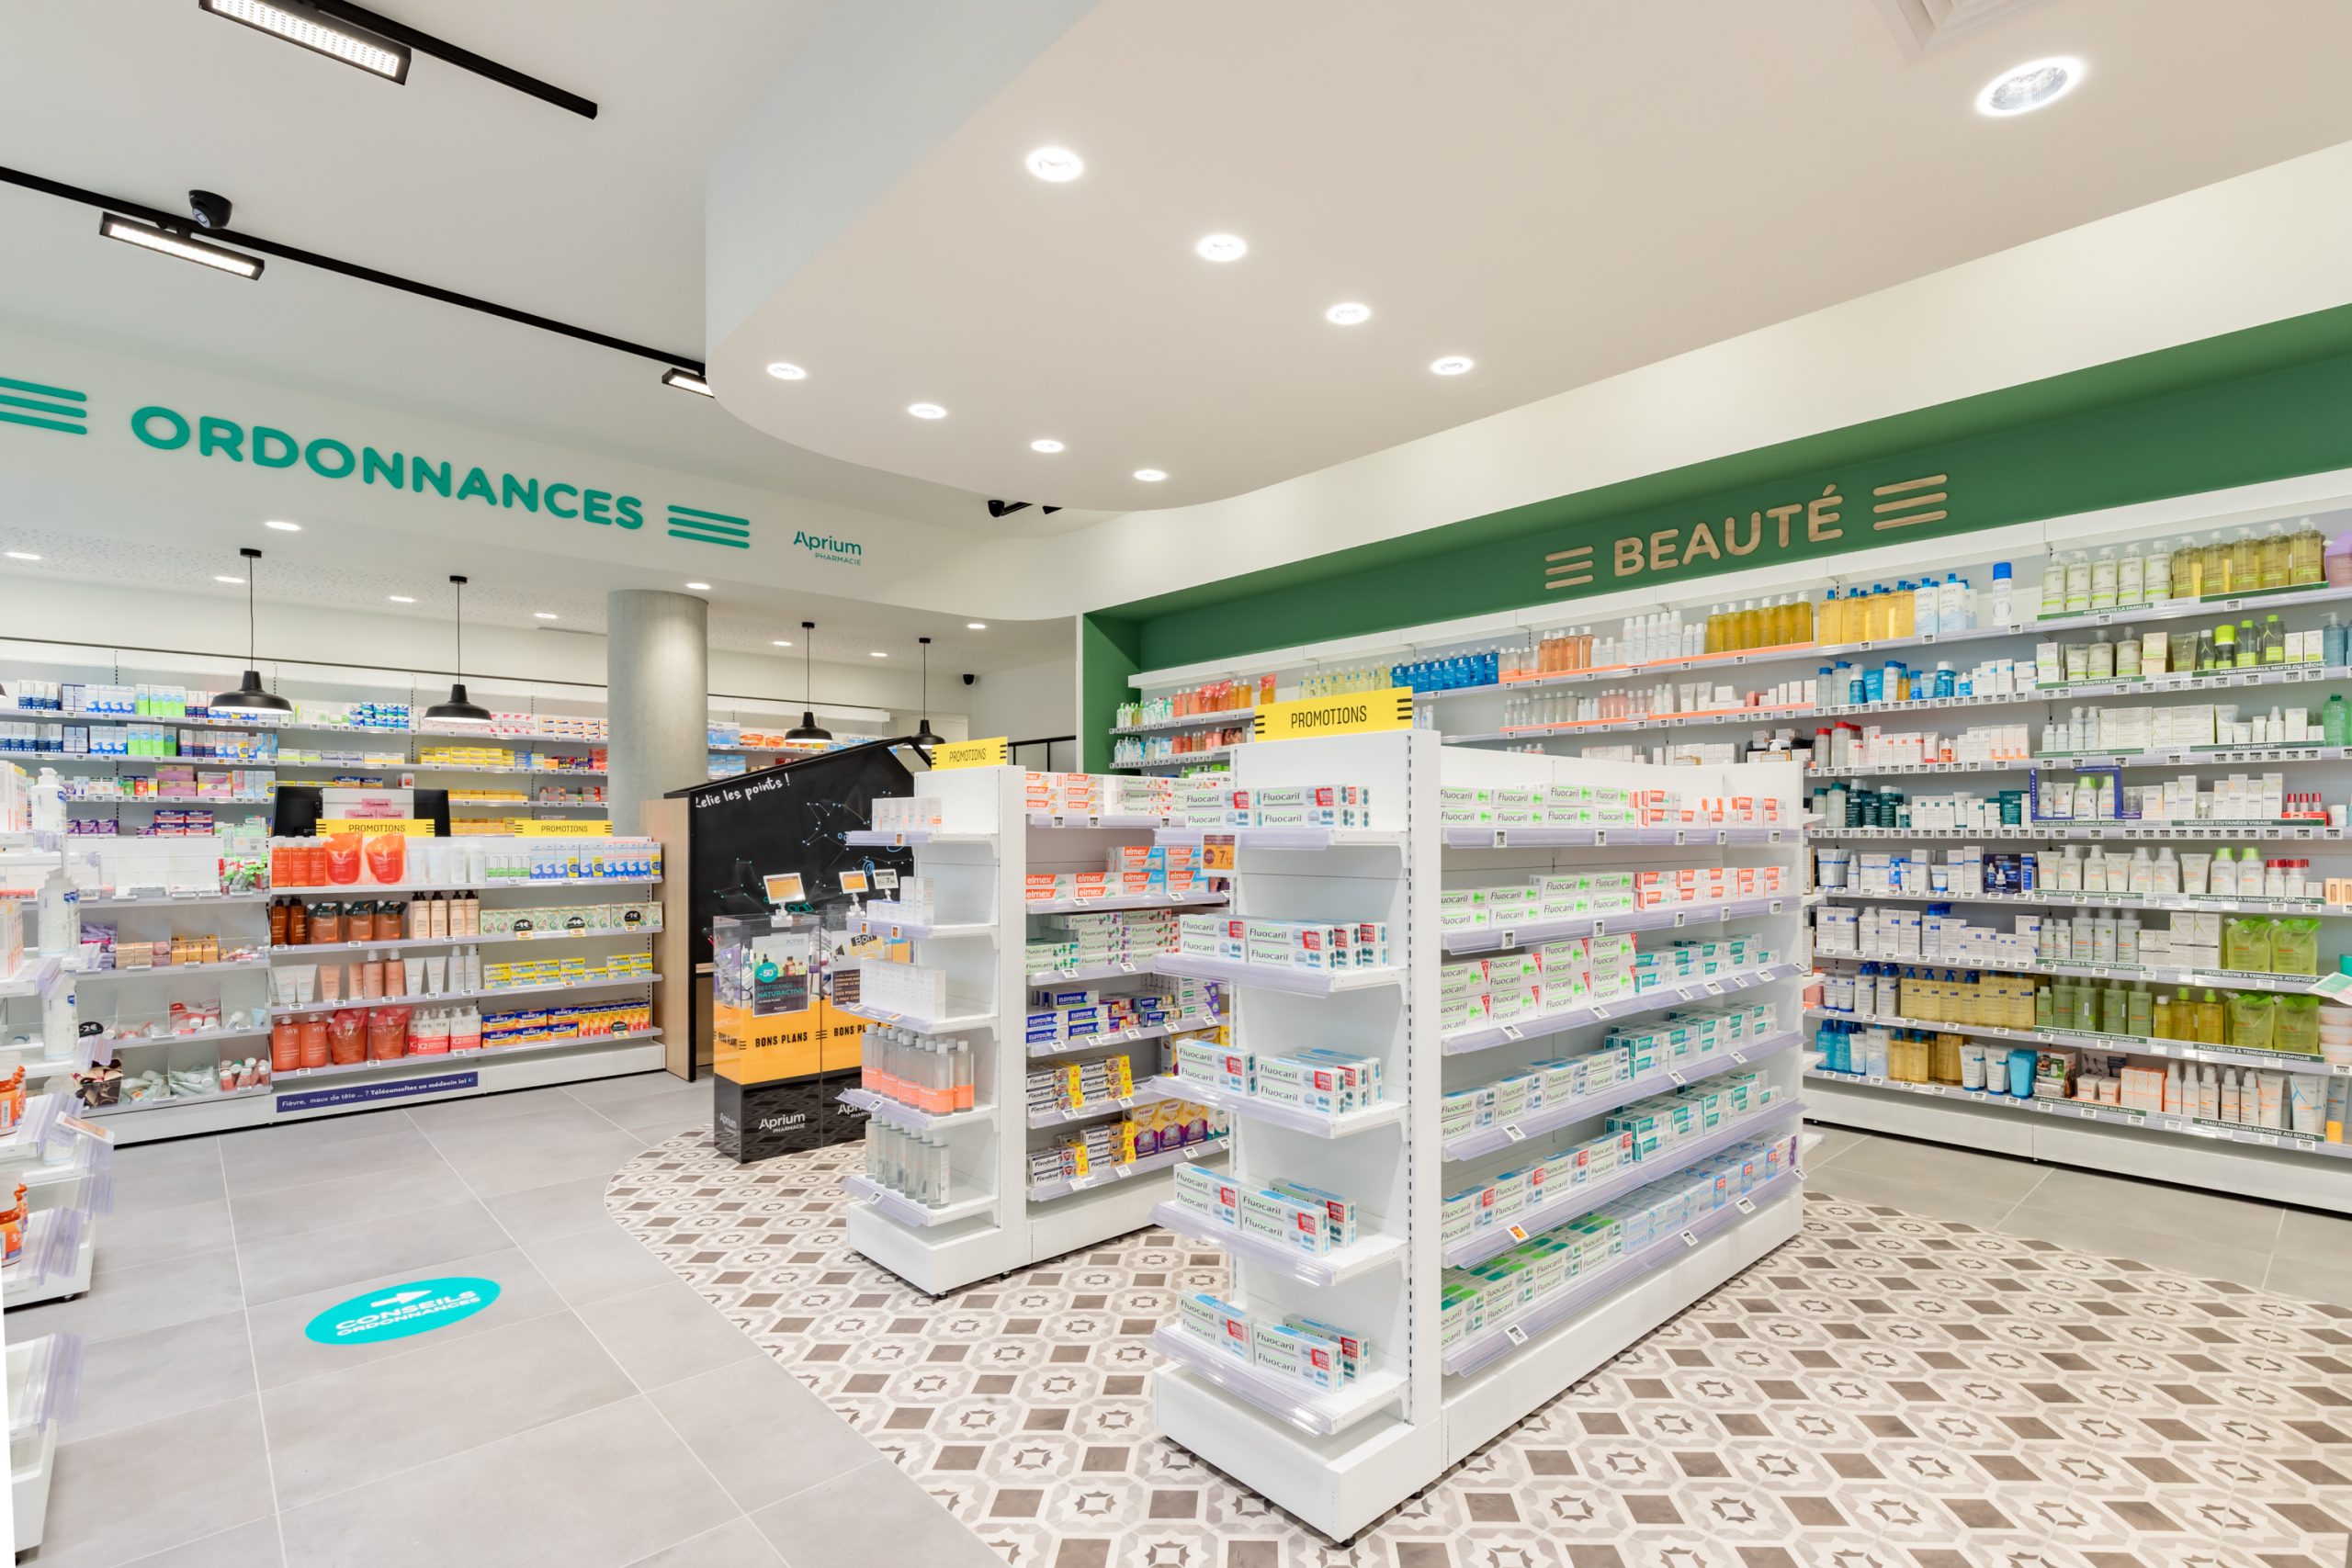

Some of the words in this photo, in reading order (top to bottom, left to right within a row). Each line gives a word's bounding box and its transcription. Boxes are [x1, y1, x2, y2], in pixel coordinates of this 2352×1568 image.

[130, 405, 644, 531] ORDONNANCES
[1613, 483, 1844, 578] BEAUTÉ
[793, 530, 862, 556] Aprium
[815, 552, 862, 566] PHARMACIE
[1291, 705, 1367, 728] PROMOTIONS
[949, 748, 987, 762] PROMOTIONS
[722, 789, 742, 802] les
[744, 776, 783, 801] points
[1550, 787, 1579, 797] Fluocaril
[1596, 790, 1618, 800] Fluocaril
[1186, 795, 1220, 804] Fluocaril
[1262, 792, 1300, 802] Fluocaril
[1498, 792, 1529, 802] Fluocaril
[1187, 815, 1221, 824] Fluocaril
[1264, 814, 1302, 824] Fluocaril
[1441, 811, 1475, 821] Fluocaril
[1498, 812, 1528, 822] Fluocaril
[1548, 810, 1577, 820] Fluocaril
[1598, 811, 1623, 820] Fluocaril
[348, 823, 406, 833] PROMOTIONS
[540, 824, 588, 833] PROMOTIONS
[1125, 848, 1148, 856] elmex
[1169, 847, 1191, 855] elmex
[1026, 875, 1051, 886] elmex
[1077, 874, 1101, 883] elmex
[1170, 872, 1192, 880] elmex
[1595, 877, 1620, 887] Fluocaril
[1078, 887, 1102, 897] elmex
[1545, 881, 1577, 891] Fluocaril
[1490, 891, 1521, 900] Fluocaril
[1544, 903, 1574, 914] Fluocaril
[1593, 899, 1620, 909] Fluocaril
[1495, 910, 1524, 920] Fluocaril
[1182, 920, 1215, 931] Fluocaril
[1250, 928, 1287, 940] Fluocaril
[1182, 941, 1215, 953] Fluocaril
[1545, 944, 1571, 955] Fluocaril
[1593, 938, 1619, 949] Fluocaril
[1250, 949, 1289, 962] Fluocaril
[1490, 959, 1521, 970] Fluocaril
[1490, 976, 1521, 986] Fluocaril
[757, 987, 805, 998] NATURACTIVE
[1594, 987, 1619, 999] Fluocaril
[1545, 997, 1572, 1009] Fluocaril
[833, 1024, 854, 1037] BONS
[755, 1034, 778, 1048] BONS
[781, 1032, 808, 1044] PLANS
[1179, 1047, 1213, 1062] Fluocaril
[2243, 1049, 2278, 1057] TENDANCE
[1181, 1067, 1214, 1082] Fluocaril
[1260, 1064, 1297, 1079] Fluocaril
[330, 1093, 340, 1101] de
[370, 1084, 417, 1096] Téléconsultez
[428, 1079, 458, 1089] médecin
[1261, 1085, 1298, 1101] Fluocaril
[1441, 1100, 1472, 1114] Fluocaril
[1498, 1104, 1523, 1118] Fluocaril
[758, 1112, 806, 1130] Aprium
[773, 1123, 806, 1134] PHARMACIE
[1442, 1121, 1472, 1136] Fluocaril
[2293, 1133, 2315, 1141] SOLEIL
[1176, 1171, 1208, 1190] Fluocaril
[1496, 1180, 1522, 1197] Fluocaril
[1177, 1191, 1208, 1211] Fluocaril
[1243, 1195, 1282, 1215] Fluocaril
[1441, 1202, 1471, 1221] Fluocaril
[1495, 1200, 1522, 1216] Fluocaril
[1245, 1216, 1283, 1237] Fluocaril
[1441, 1223, 1470, 1240] Fluocaril
[334, 1290, 477, 1331] CONSEILS
[1181, 1299, 1214, 1321] Fluocaril
[336, 1296, 481, 1337] ORDONNANCES
[1182, 1318, 1216, 1341] Fluocaril
[1256, 1331, 1295, 1351] Fluocaril
[1258, 1352, 1296, 1373] Fluocaril
